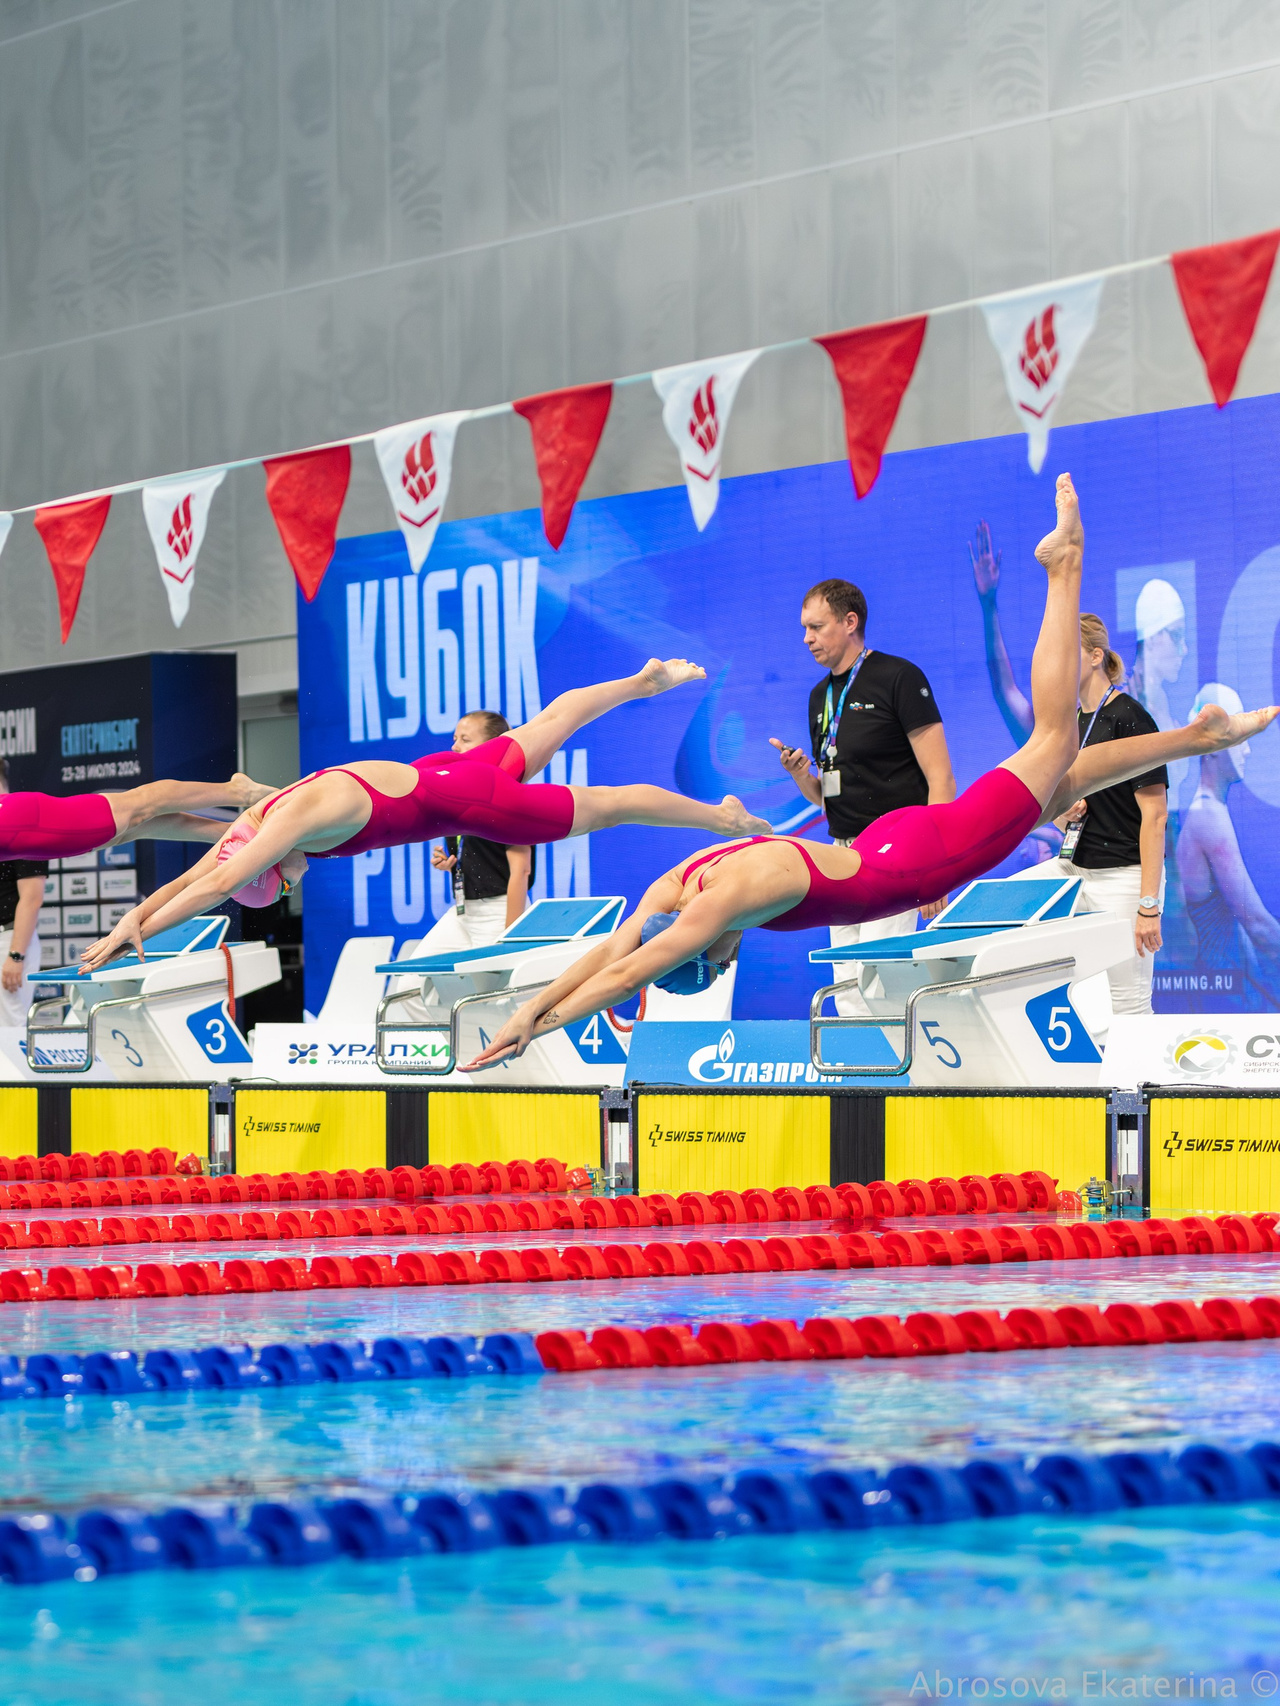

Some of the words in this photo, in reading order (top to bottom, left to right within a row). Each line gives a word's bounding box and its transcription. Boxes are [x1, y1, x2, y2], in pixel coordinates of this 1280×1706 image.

[346, 557, 541, 743] КУБОК
[1151, 975, 1233, 990] IMMING.RU
[205, 1018, 227, 1055] 3
[579, 1015, 602, 1054] 4
[919, 1021, 962, 1068] 5
[1048, 1007, 1072, 1051] 5
[111, 1029, 143, 1067] 3
[256, 1121, 287, 1132] SWISS
[289, 1122, 321, 1133] TIMING
[664, 1130, 704, 1142] SWISS
[706, 1131, 746, 1143] TIMING
[1184, 1138, 1235, 1151] SWISS
[1238, 1139, 1280, 1152] TIMIN
